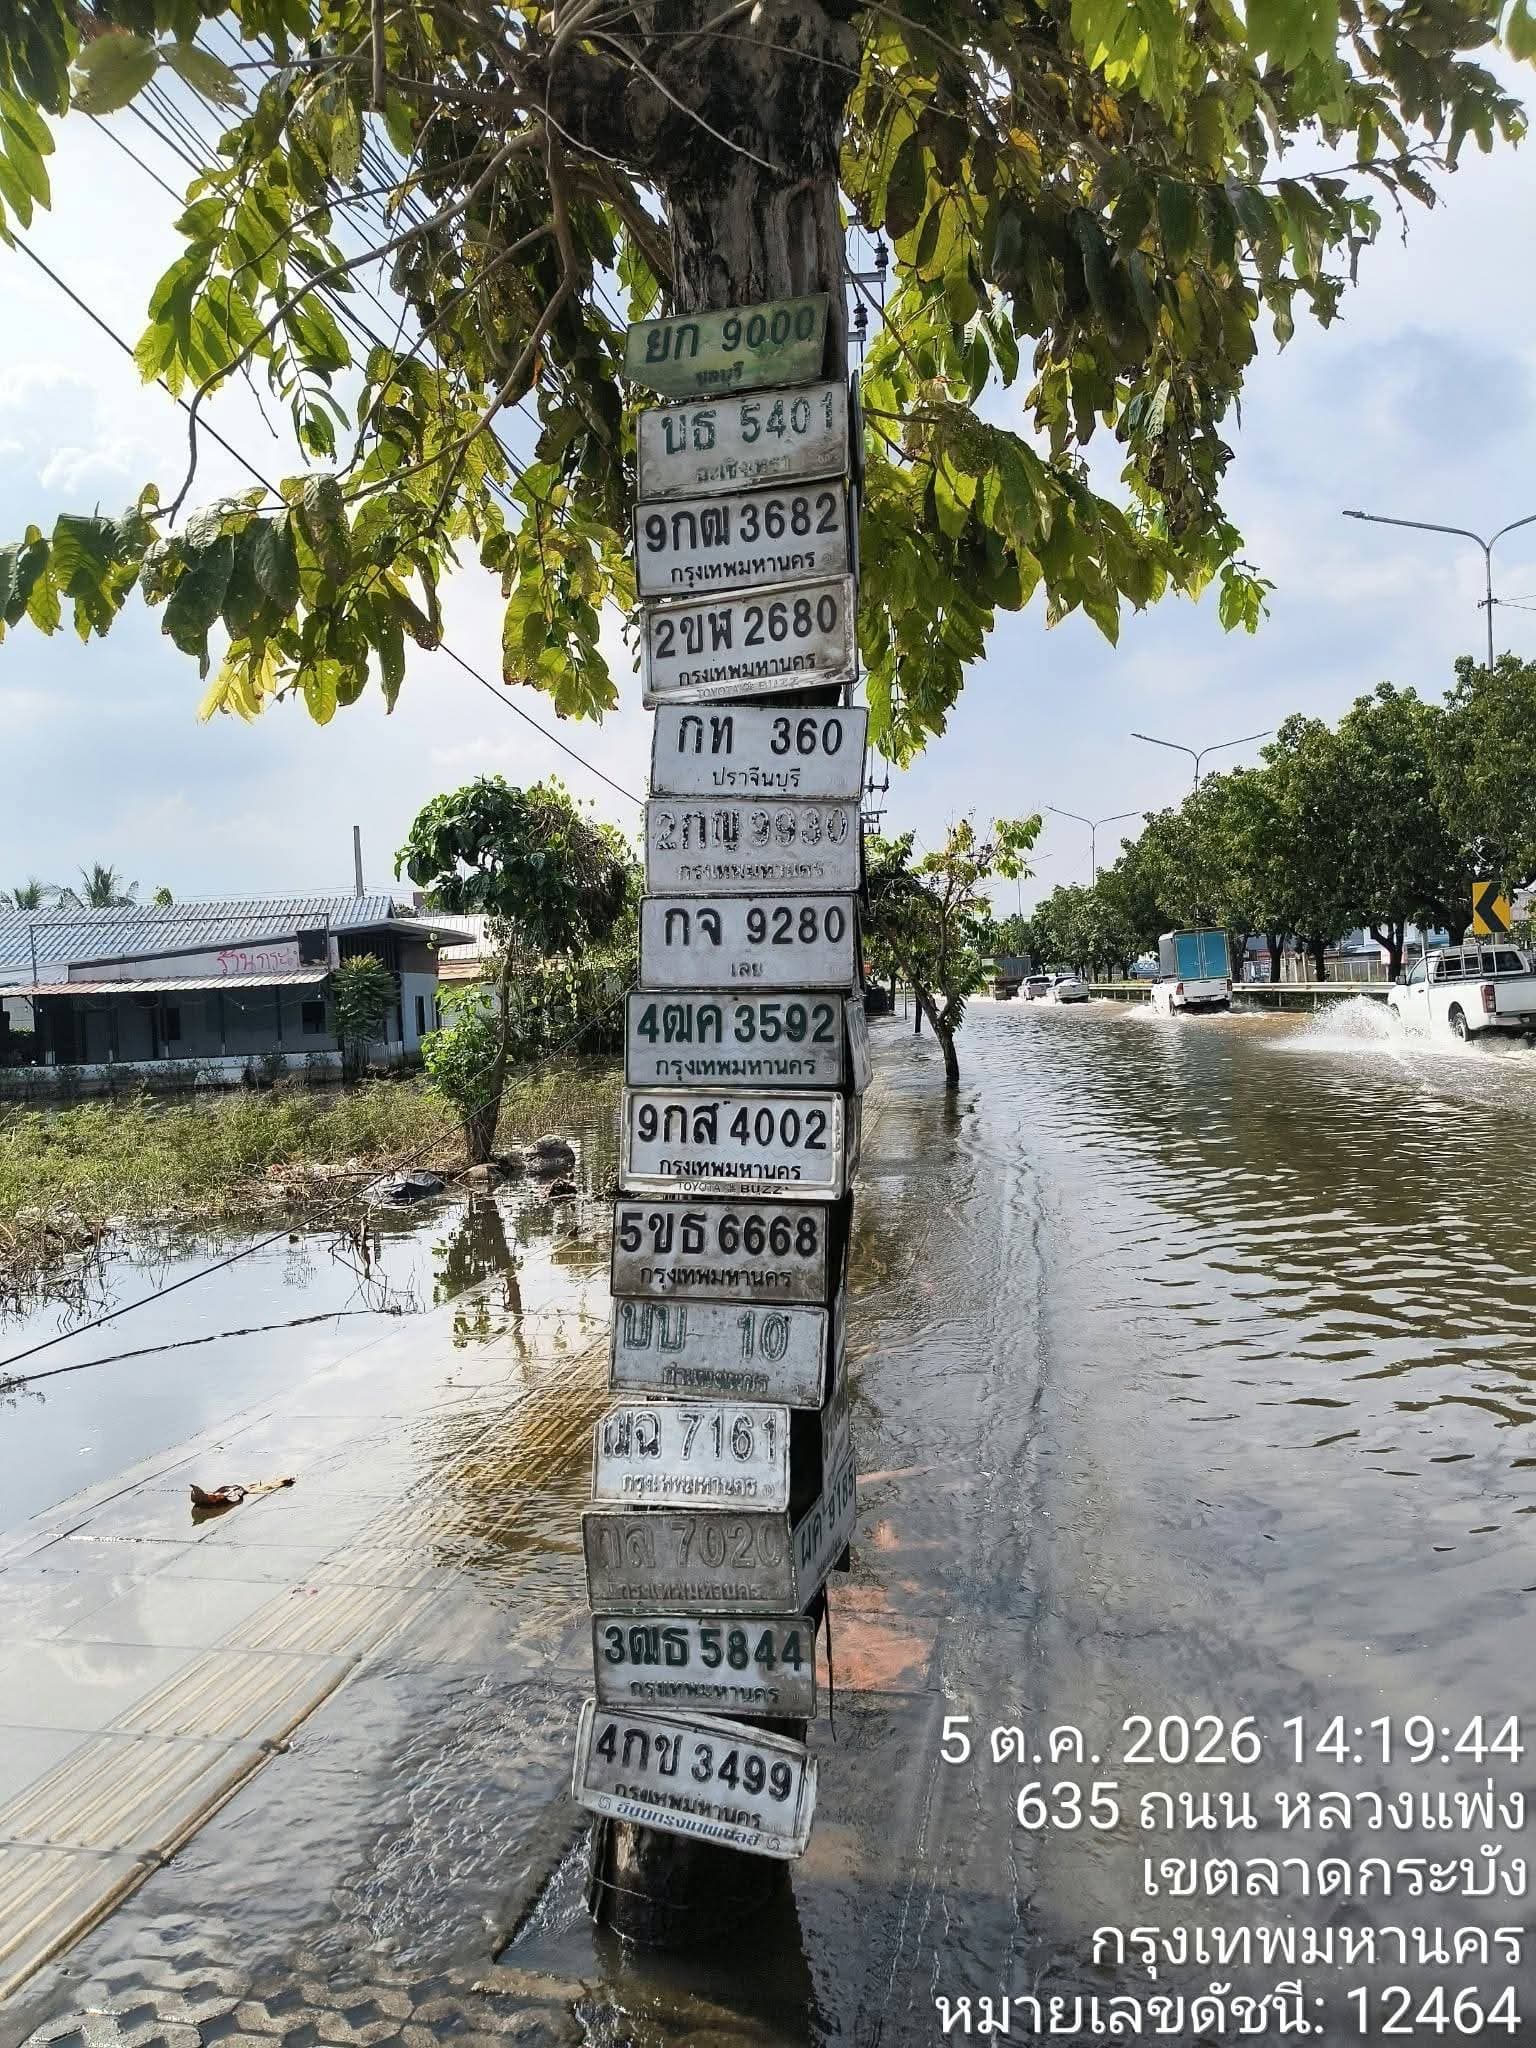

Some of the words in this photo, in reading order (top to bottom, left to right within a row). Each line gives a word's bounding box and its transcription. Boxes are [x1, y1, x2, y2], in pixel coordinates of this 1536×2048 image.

[645, 323, 699, 363] ยก
[721, 306, 815, 352] 9000
[660, 409, 717, 455] บธ
[739, 391, 833, 443] 5401
[739, 492, 839, 543] 3682
[671, 551, 815, 588] กรุงเทพมหานคร
[743, 594, 838, 647] 2680
[679, 652, 816, 686] กรงเทพมหานคร
[677, 715, 734, 754] กท
[770, 716, 843, 756] 360
[712, 766, 801, 792] ปราจีนบุรี
[751, 807, 848, 847] 9930
[665, 907, 722, 946] กจ
[746, 905, 845, 945] 9280
[730, 962, 763, 978] เลย
[734, 1003, 835, 1044] 3592
[655, 1058, 816, 1081] กรุงเทพมหานคร
[637, 1102, 719, 1146] 9กส
[729, 1106, 827, 1150] 4002
[659, 1158, 801, 1180] กรงเทพมหานคร
[620, 1212, 707, 1254] 5ขธ
[718, 1213, 817, 1257] 6668
[640, 1266, 792, 1289] กรุงเทพมหานคร
[737, 1311, 788, 1361] 10
[678, 1411, 777, 1464] 7161
[671, 1518, 781, 1568] 7020
[700, 1627, 804, 1671] 5844
[691, 1743, 793, 1803] 3499
[615, 1783, 762, 1829] กรงเทพมหานคร
